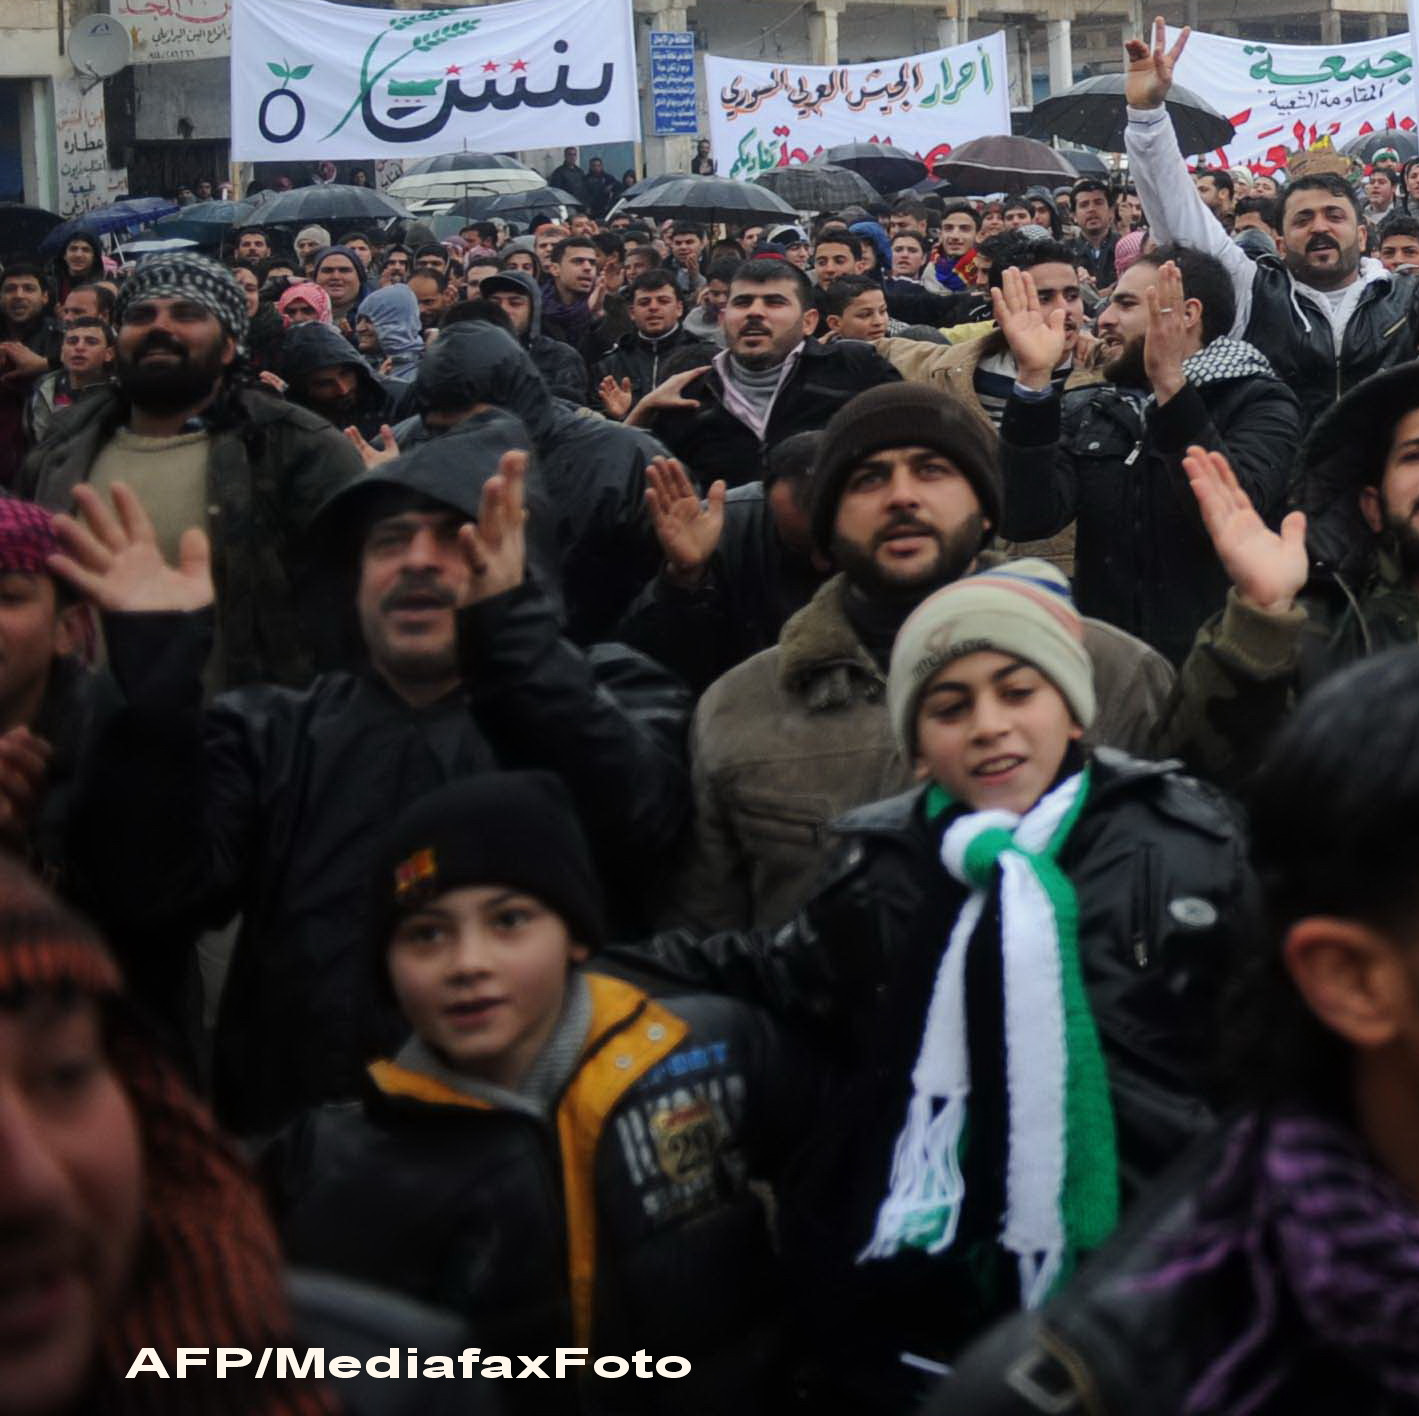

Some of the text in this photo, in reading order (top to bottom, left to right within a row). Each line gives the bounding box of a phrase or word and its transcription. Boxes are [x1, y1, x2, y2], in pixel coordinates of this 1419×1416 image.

[360, 39, 614, 143] بنش
[847, 62, 924, 116] الجيش
[918, 43, 993, 109] أحرار
[1243, 45, 1414, 85] جمعة
[720, 68, 789, 122] السوري
[788, 69, 848, 119] العربي
